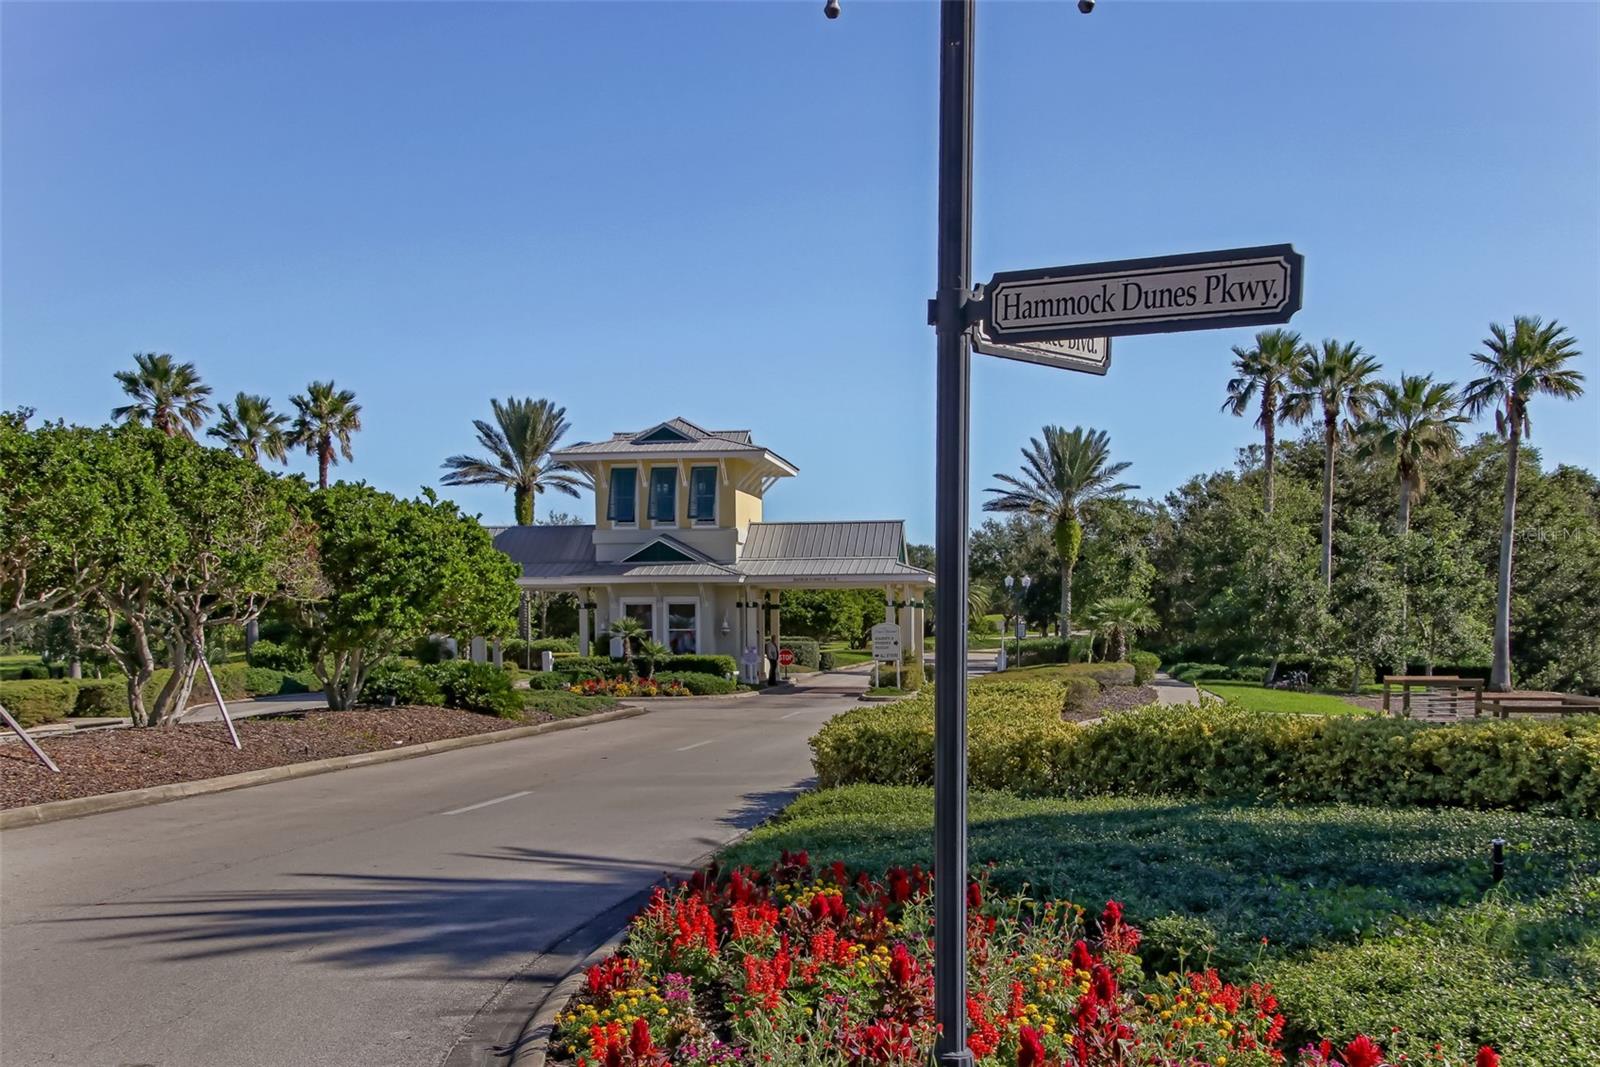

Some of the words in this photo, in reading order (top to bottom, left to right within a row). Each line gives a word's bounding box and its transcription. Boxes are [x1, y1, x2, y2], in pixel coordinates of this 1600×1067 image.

[1002, 284, 1116, 321] Hammock
[1122, 282, 1197, 311] Dunes
[1203, 273, 1278, 306] Pkwy.
